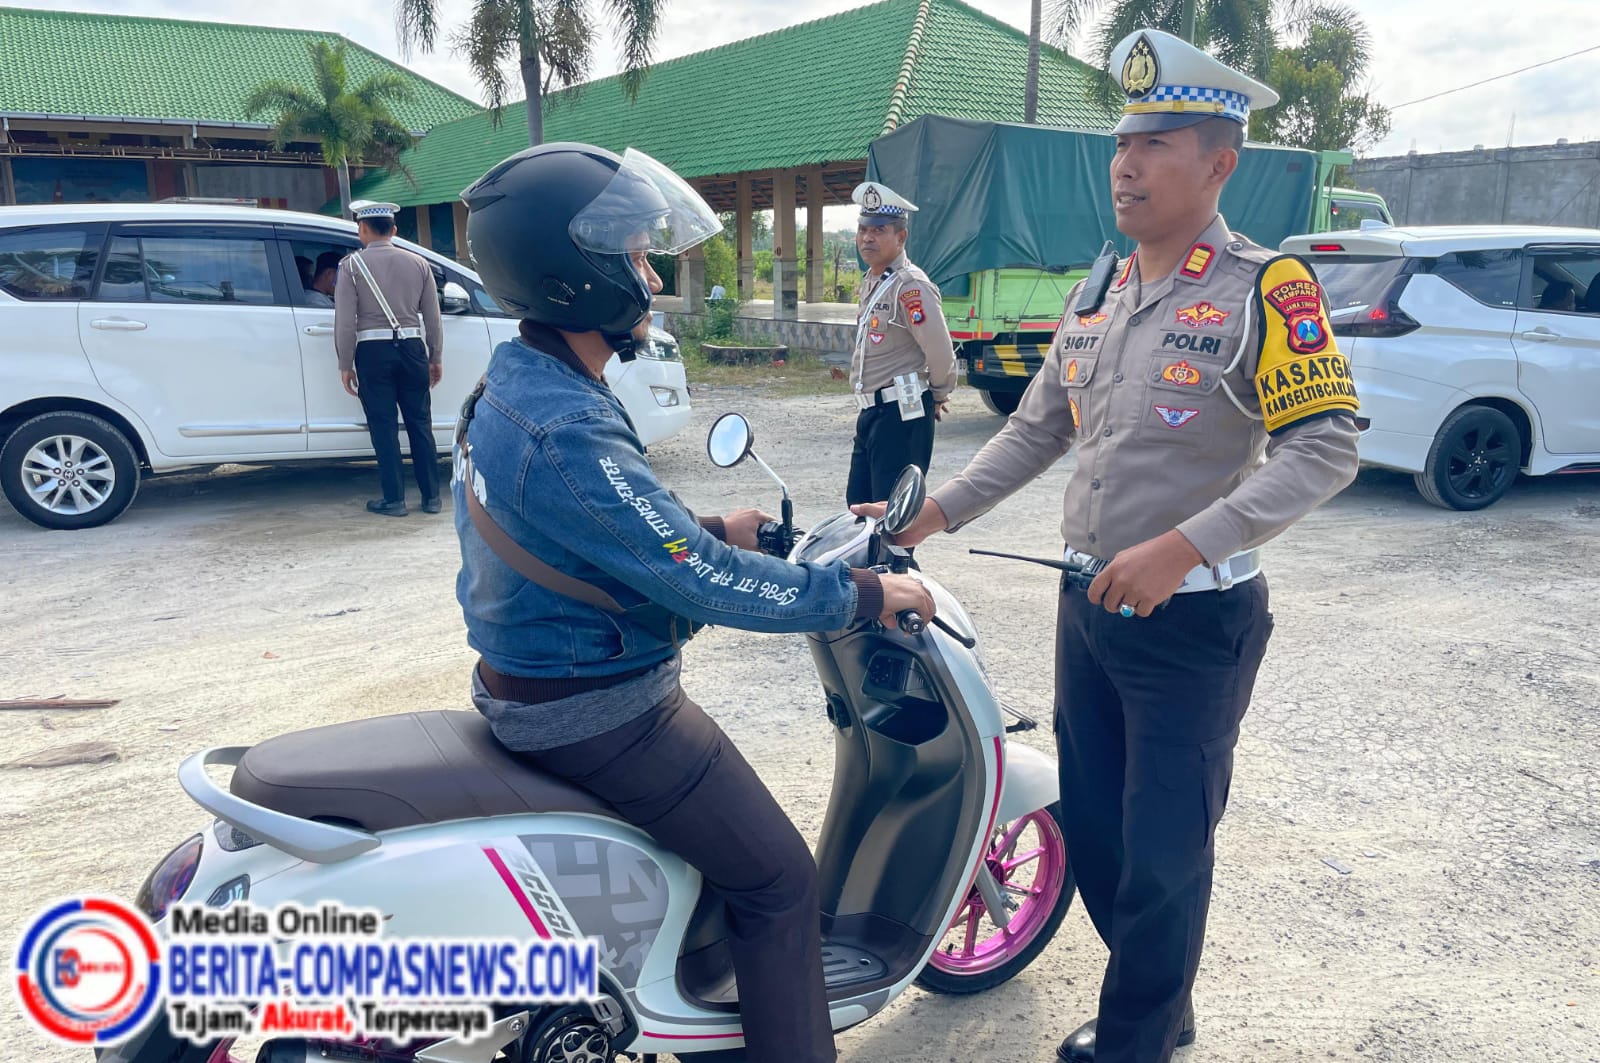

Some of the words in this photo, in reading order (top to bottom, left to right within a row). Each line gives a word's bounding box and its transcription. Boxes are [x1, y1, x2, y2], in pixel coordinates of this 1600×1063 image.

[1272, 281, 1318, 298] POLRES
[1278, 289, 1317, 303] SAMPANG
[873, 303, 889, 312] OLRI
[1064, 336, 1099, 350] SIGIT
[1162, 332, 1221, 356] POLRI
[733, 577, 759, 593] FIT
